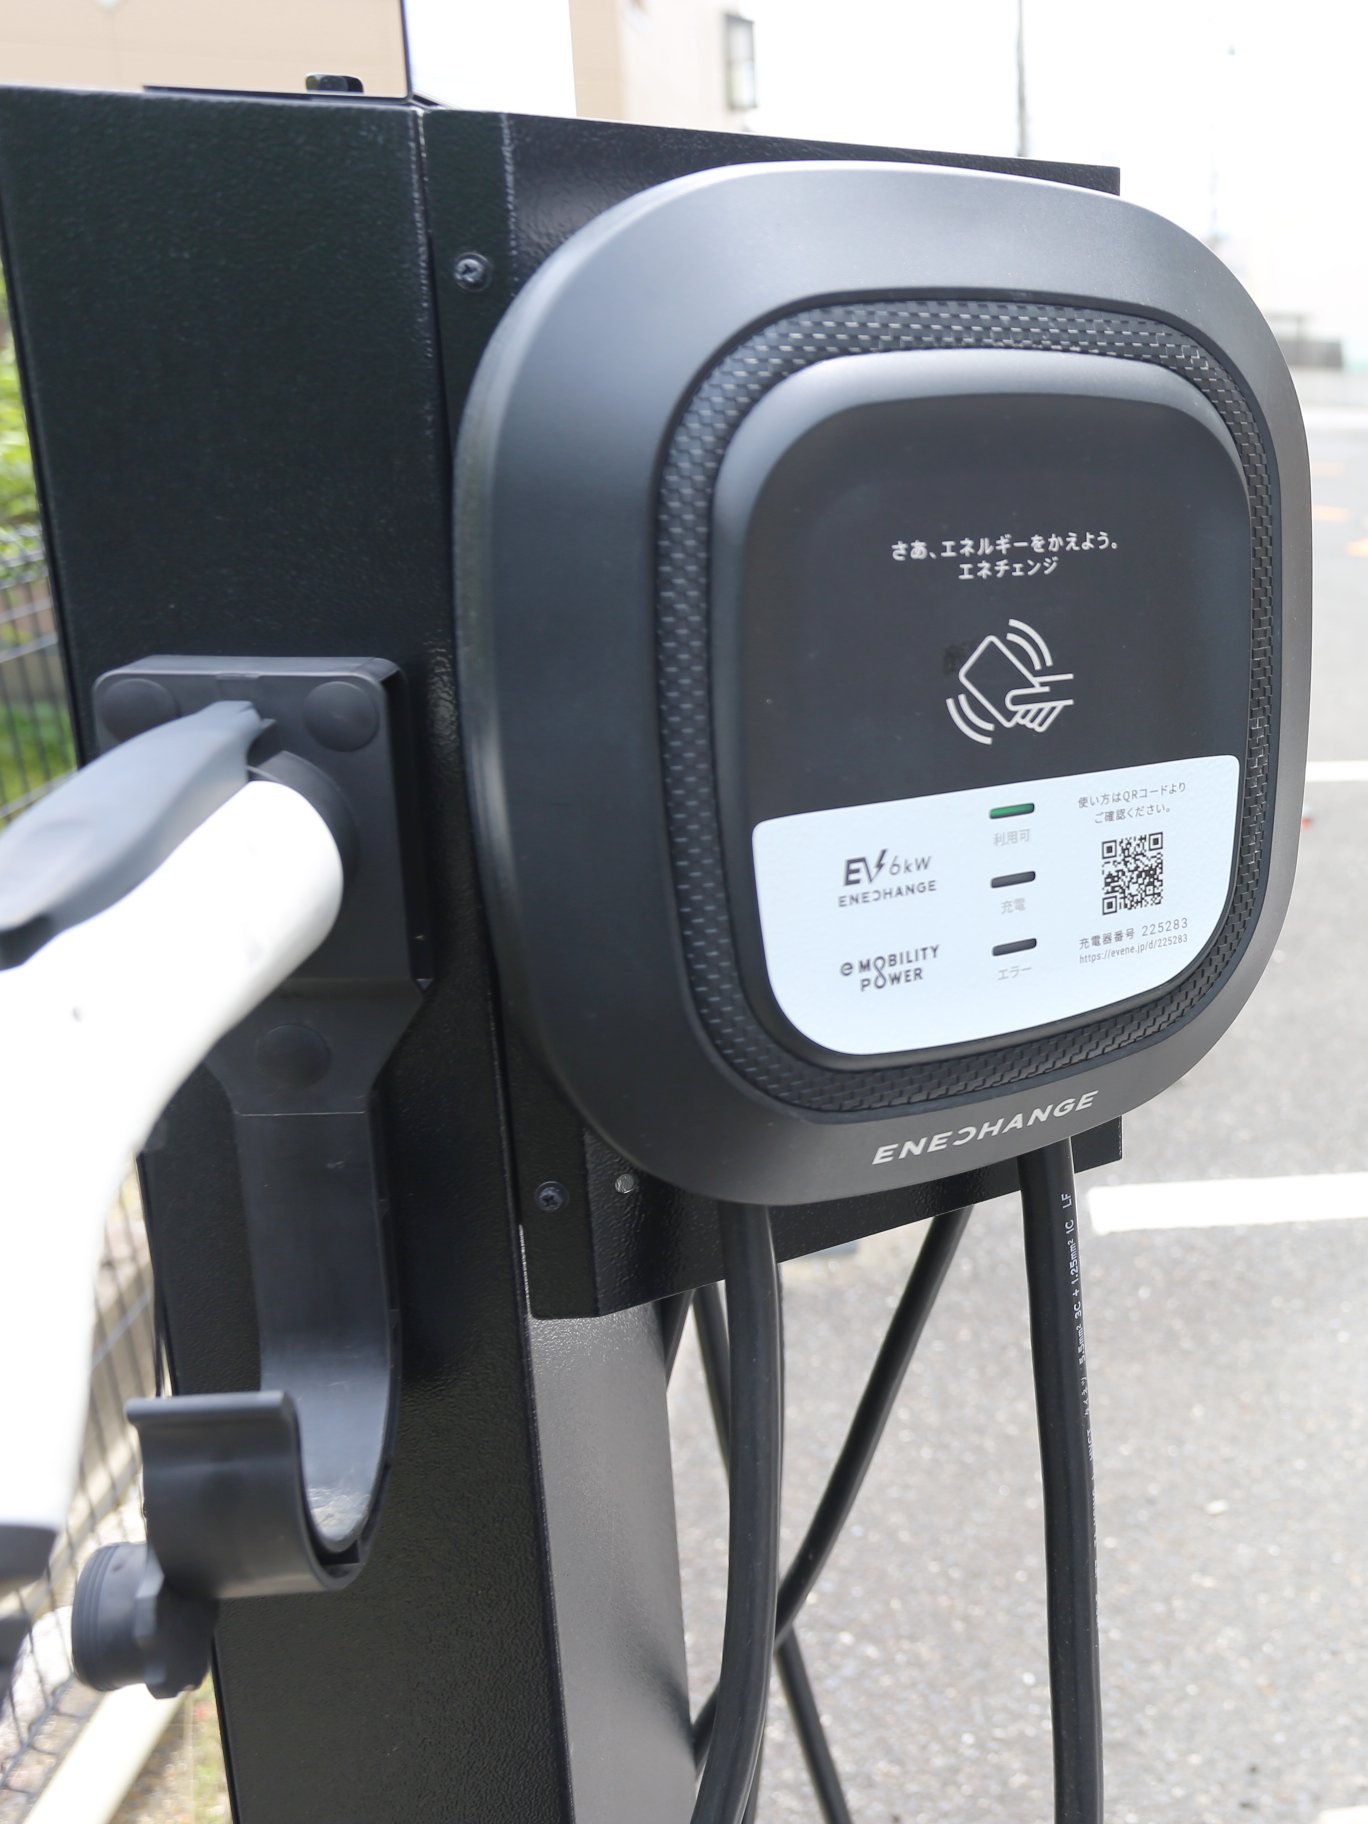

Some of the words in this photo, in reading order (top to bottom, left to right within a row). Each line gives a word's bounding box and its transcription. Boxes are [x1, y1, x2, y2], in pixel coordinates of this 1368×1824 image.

[891, 531, 1118, 561] さあ、エネルギーをかえよう。
[958, 556, 1059, 580] エネチェンジ
[1078, 782, 1186, 808] 使い方はQRコードより
[1094, 804, 1170, 823] ご確認ください。
[993, 829, 1031, 847] 利用可
[1001, 898, 1026, 914] 充電
[1079, 927, 1135, 951] 充電器番号
[1141, 917, 1188, 937] 225283
[1079, 933, 1188, 964] https://evene.jp/d/225283
[998, 966, 1033, 981] エラー
[872, 1090, 1099, 1165] ENECHANGE
[1061, 1193, 1072, 1209] LF
